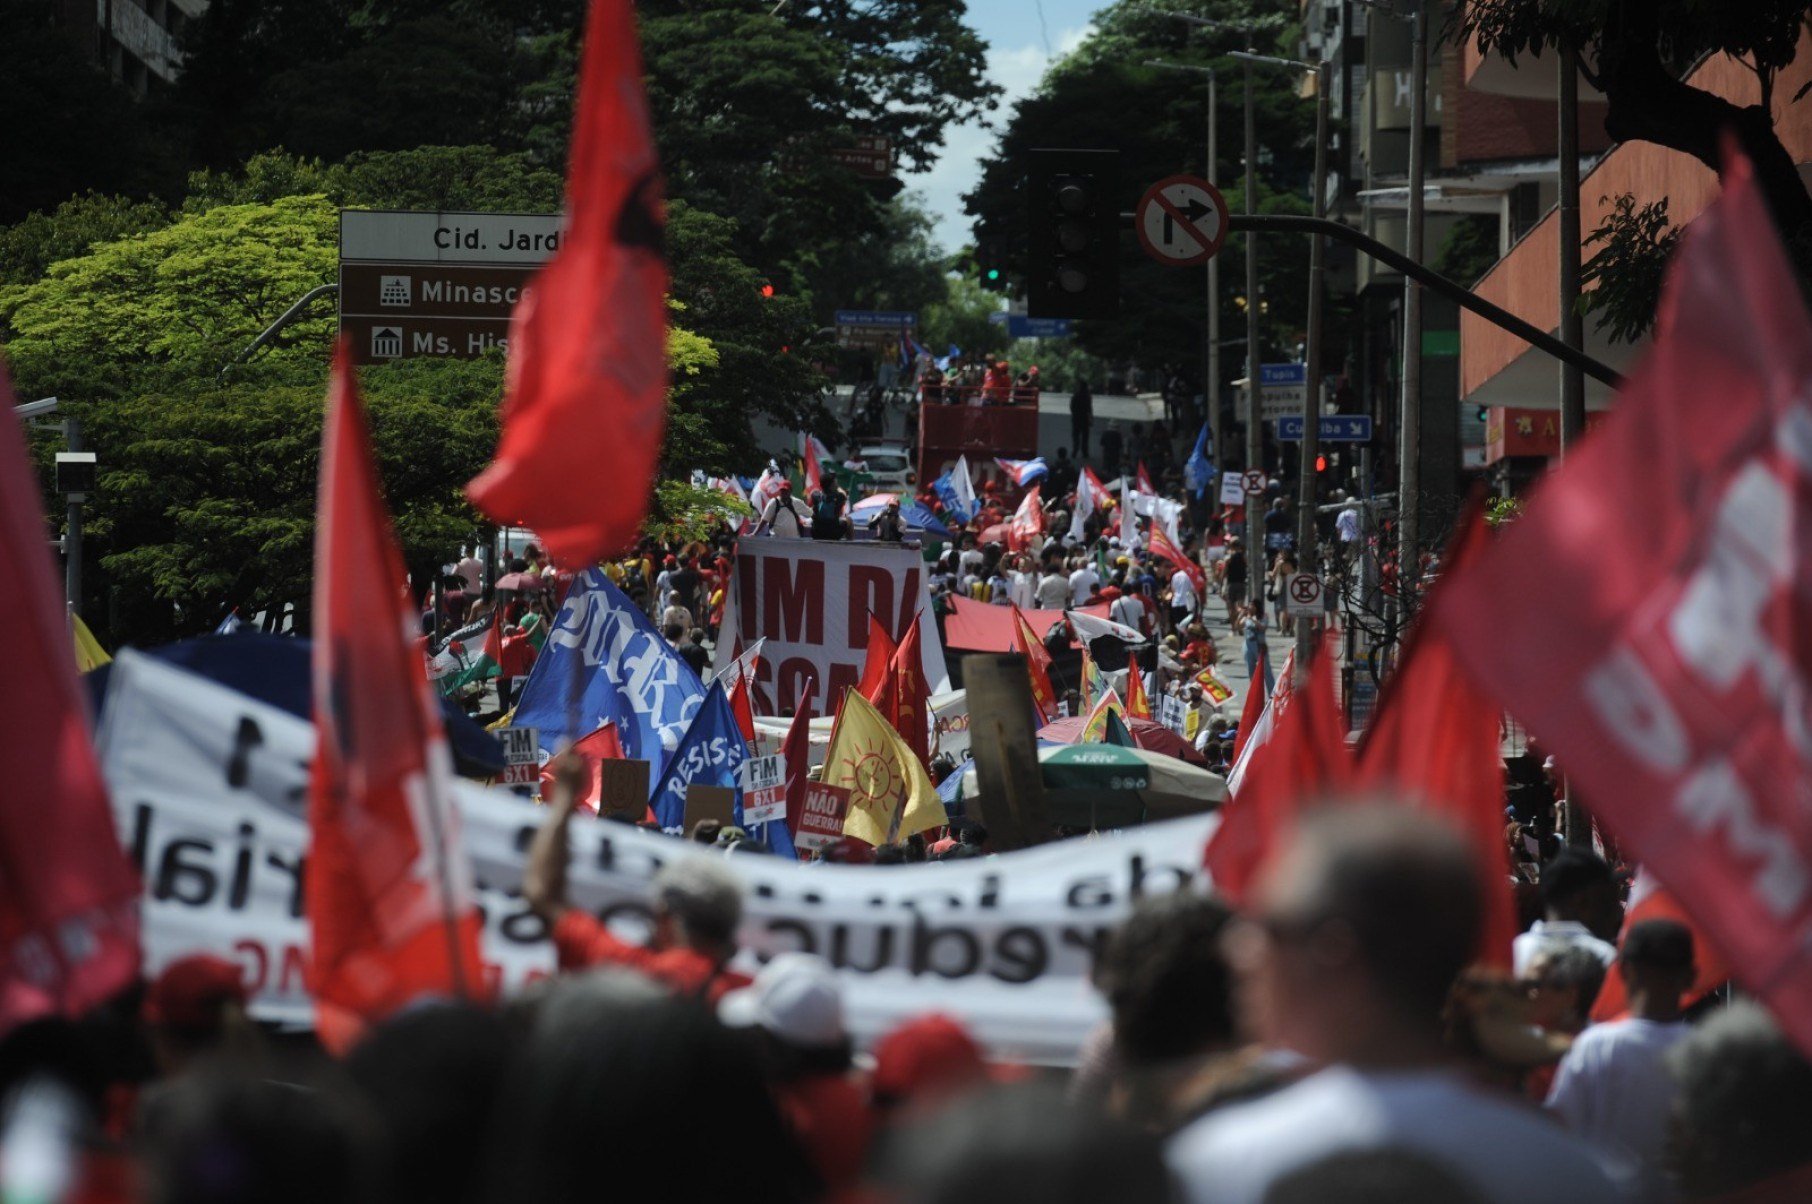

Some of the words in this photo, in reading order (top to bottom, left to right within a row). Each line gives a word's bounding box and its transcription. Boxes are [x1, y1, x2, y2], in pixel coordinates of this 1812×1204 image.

[434, 227, 487, 250] Cid.
[413, 332, 456, 354] Ms.
[1286, 421, 1342, 435] Cuiba
[503, 764, 531, 783] 6X1
[749, 756, 779, 782] FIM
[753, 788, 776, 808] 6X1
[805, 788, 838, 816] NÃO
